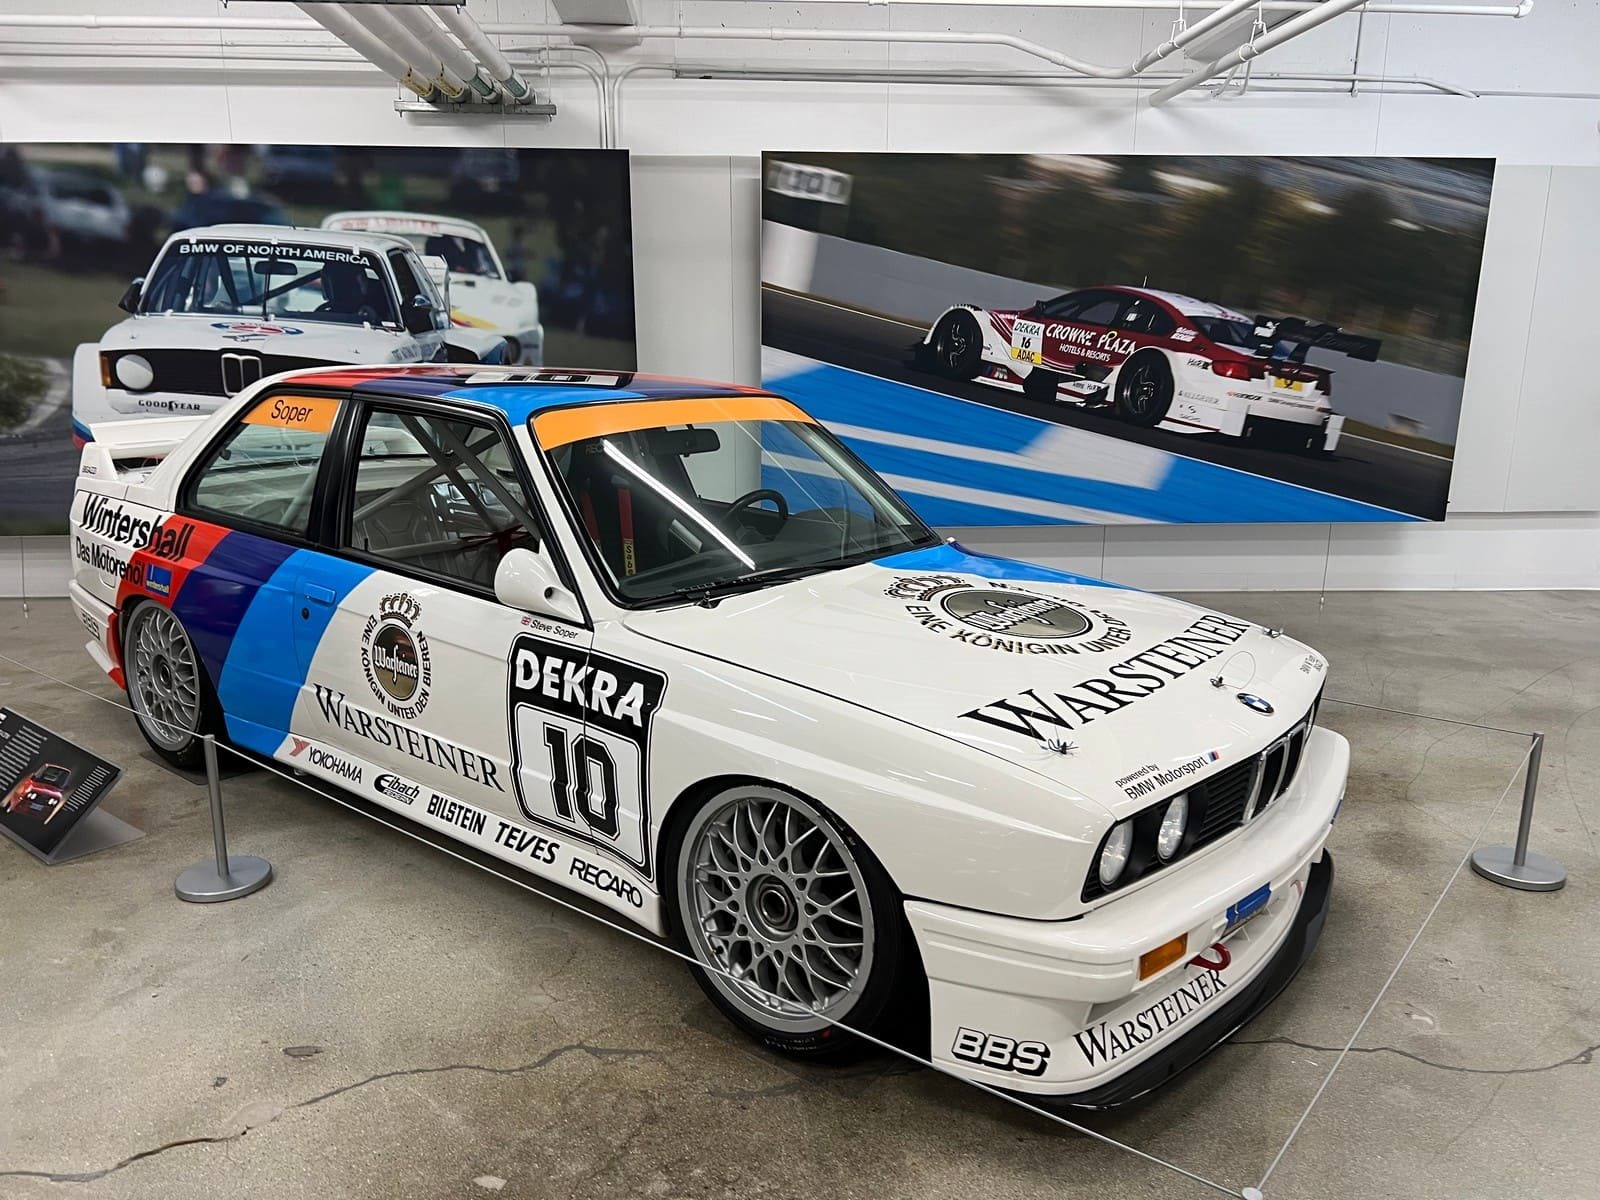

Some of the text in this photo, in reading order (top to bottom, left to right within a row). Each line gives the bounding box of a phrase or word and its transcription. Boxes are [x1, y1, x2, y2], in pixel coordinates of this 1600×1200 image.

[179, 244, 370, 266] BMW OF NORTH AMERICA
[1014, 321, 1041, 336] DEKRA
[1021, 337, 1031, 349] 16
[1045, 323, 1136, 355] CROWNE PLAZA
[1017, 350, 1035, 362] ADAC
[1059, 344, 1081, 356] HOTELS
[1086, 350, 1111, 362] RESORTS
[138, 400, 201, 412] GOODYEAR
[271, 399, 312, 424] Soper
[79, 493, 196, 562] Wintershall
[76, 536, 145, 586] Das Motorenöl
[361, 614, 378, 645] EINE
[530, 619, 578, 639] Steve Soper
[905, 605, 954, 633] EINE
[951, 629, 1080, 655] KÖNIGIN
[1079, 627, 1132, 653] UNTER
[416, 630, 432, 687] BIEREN
[957, 614, 1252, 743] WARSTEINER
[415, 688, 430, 714] DEN
[515, 648, 646, 728] DEKRA
[387, 701, 417, 720] UNTER
[314, 683, 505, 793] WARSTEINER
[308, 745, 363, 785] YOKOHAMA
[543, 722, 621, 841] 10
[1115, 763, 1160, 788] powered by
[1124, 756, 1208, 800] BMW Motorsport
[374, 774, 420, 799] Eibach
[427, 794, 487, 836] BILSTEIN
[494, 821, 560, 865] TEVES
[569, 857, 644, 909] RECARO
[1073, 968, 1227, 1068] WARSTEINER
[951, 1026, 1052, 1078] BBS
